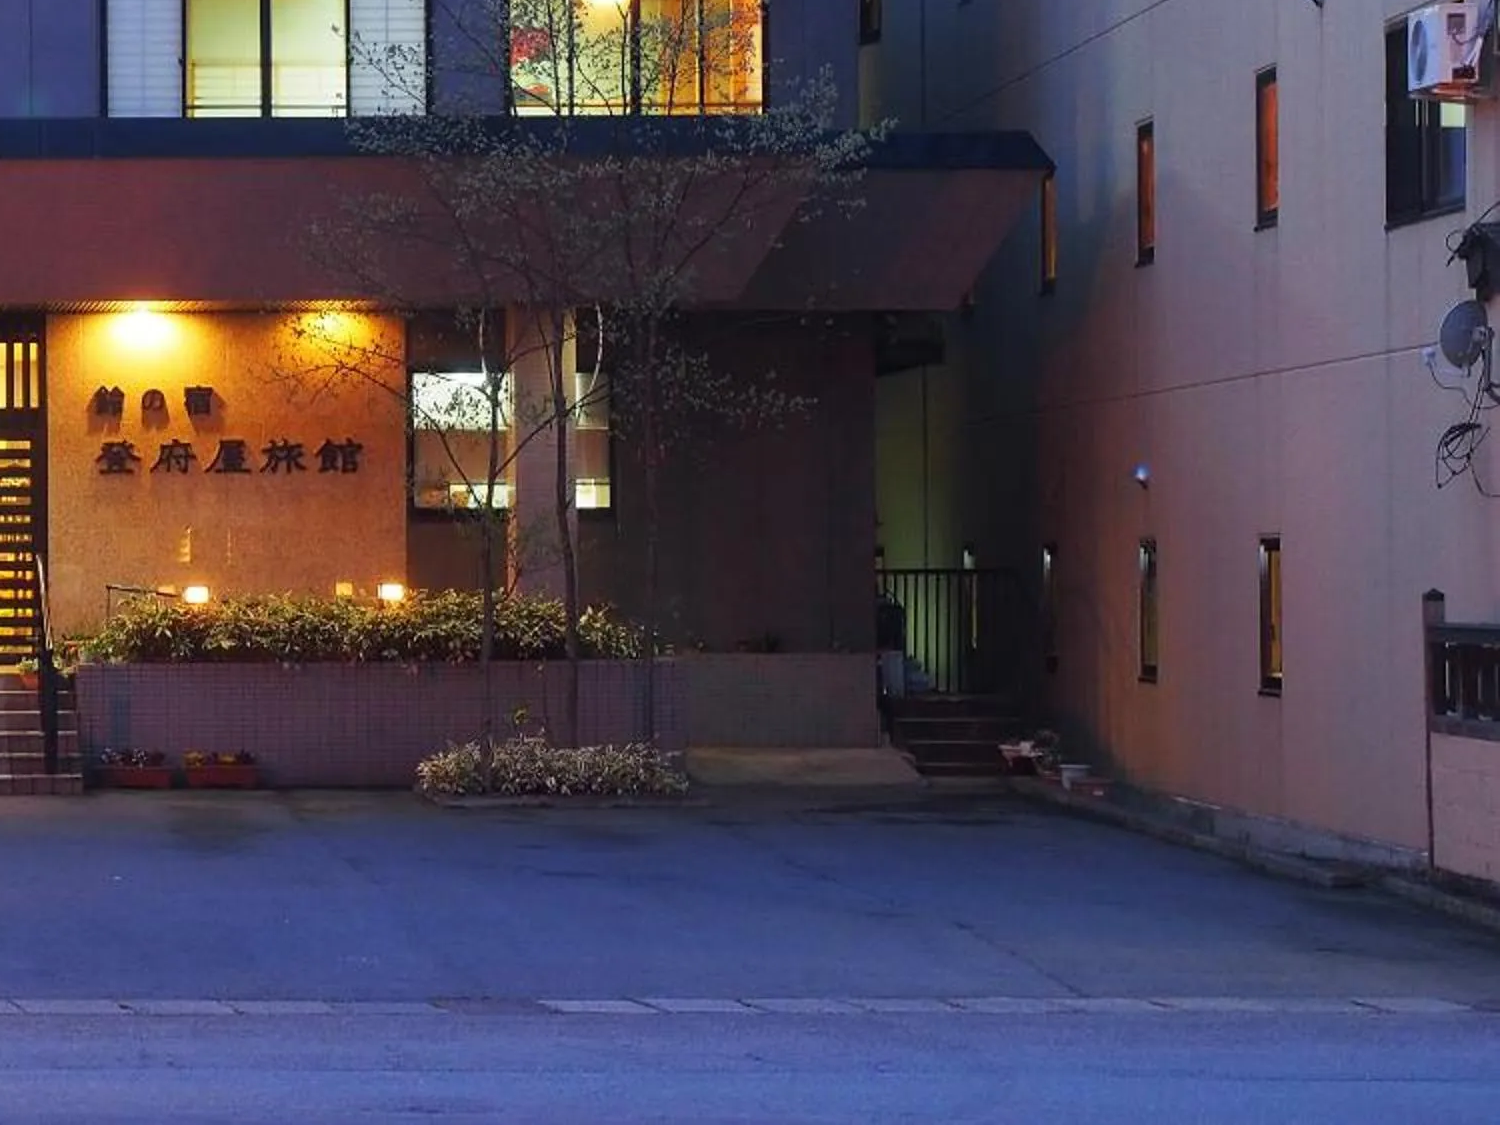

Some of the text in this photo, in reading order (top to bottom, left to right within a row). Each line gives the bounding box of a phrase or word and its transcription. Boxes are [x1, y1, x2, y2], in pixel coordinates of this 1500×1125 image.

[95, 438, 364, 475] 登府屋旅館
